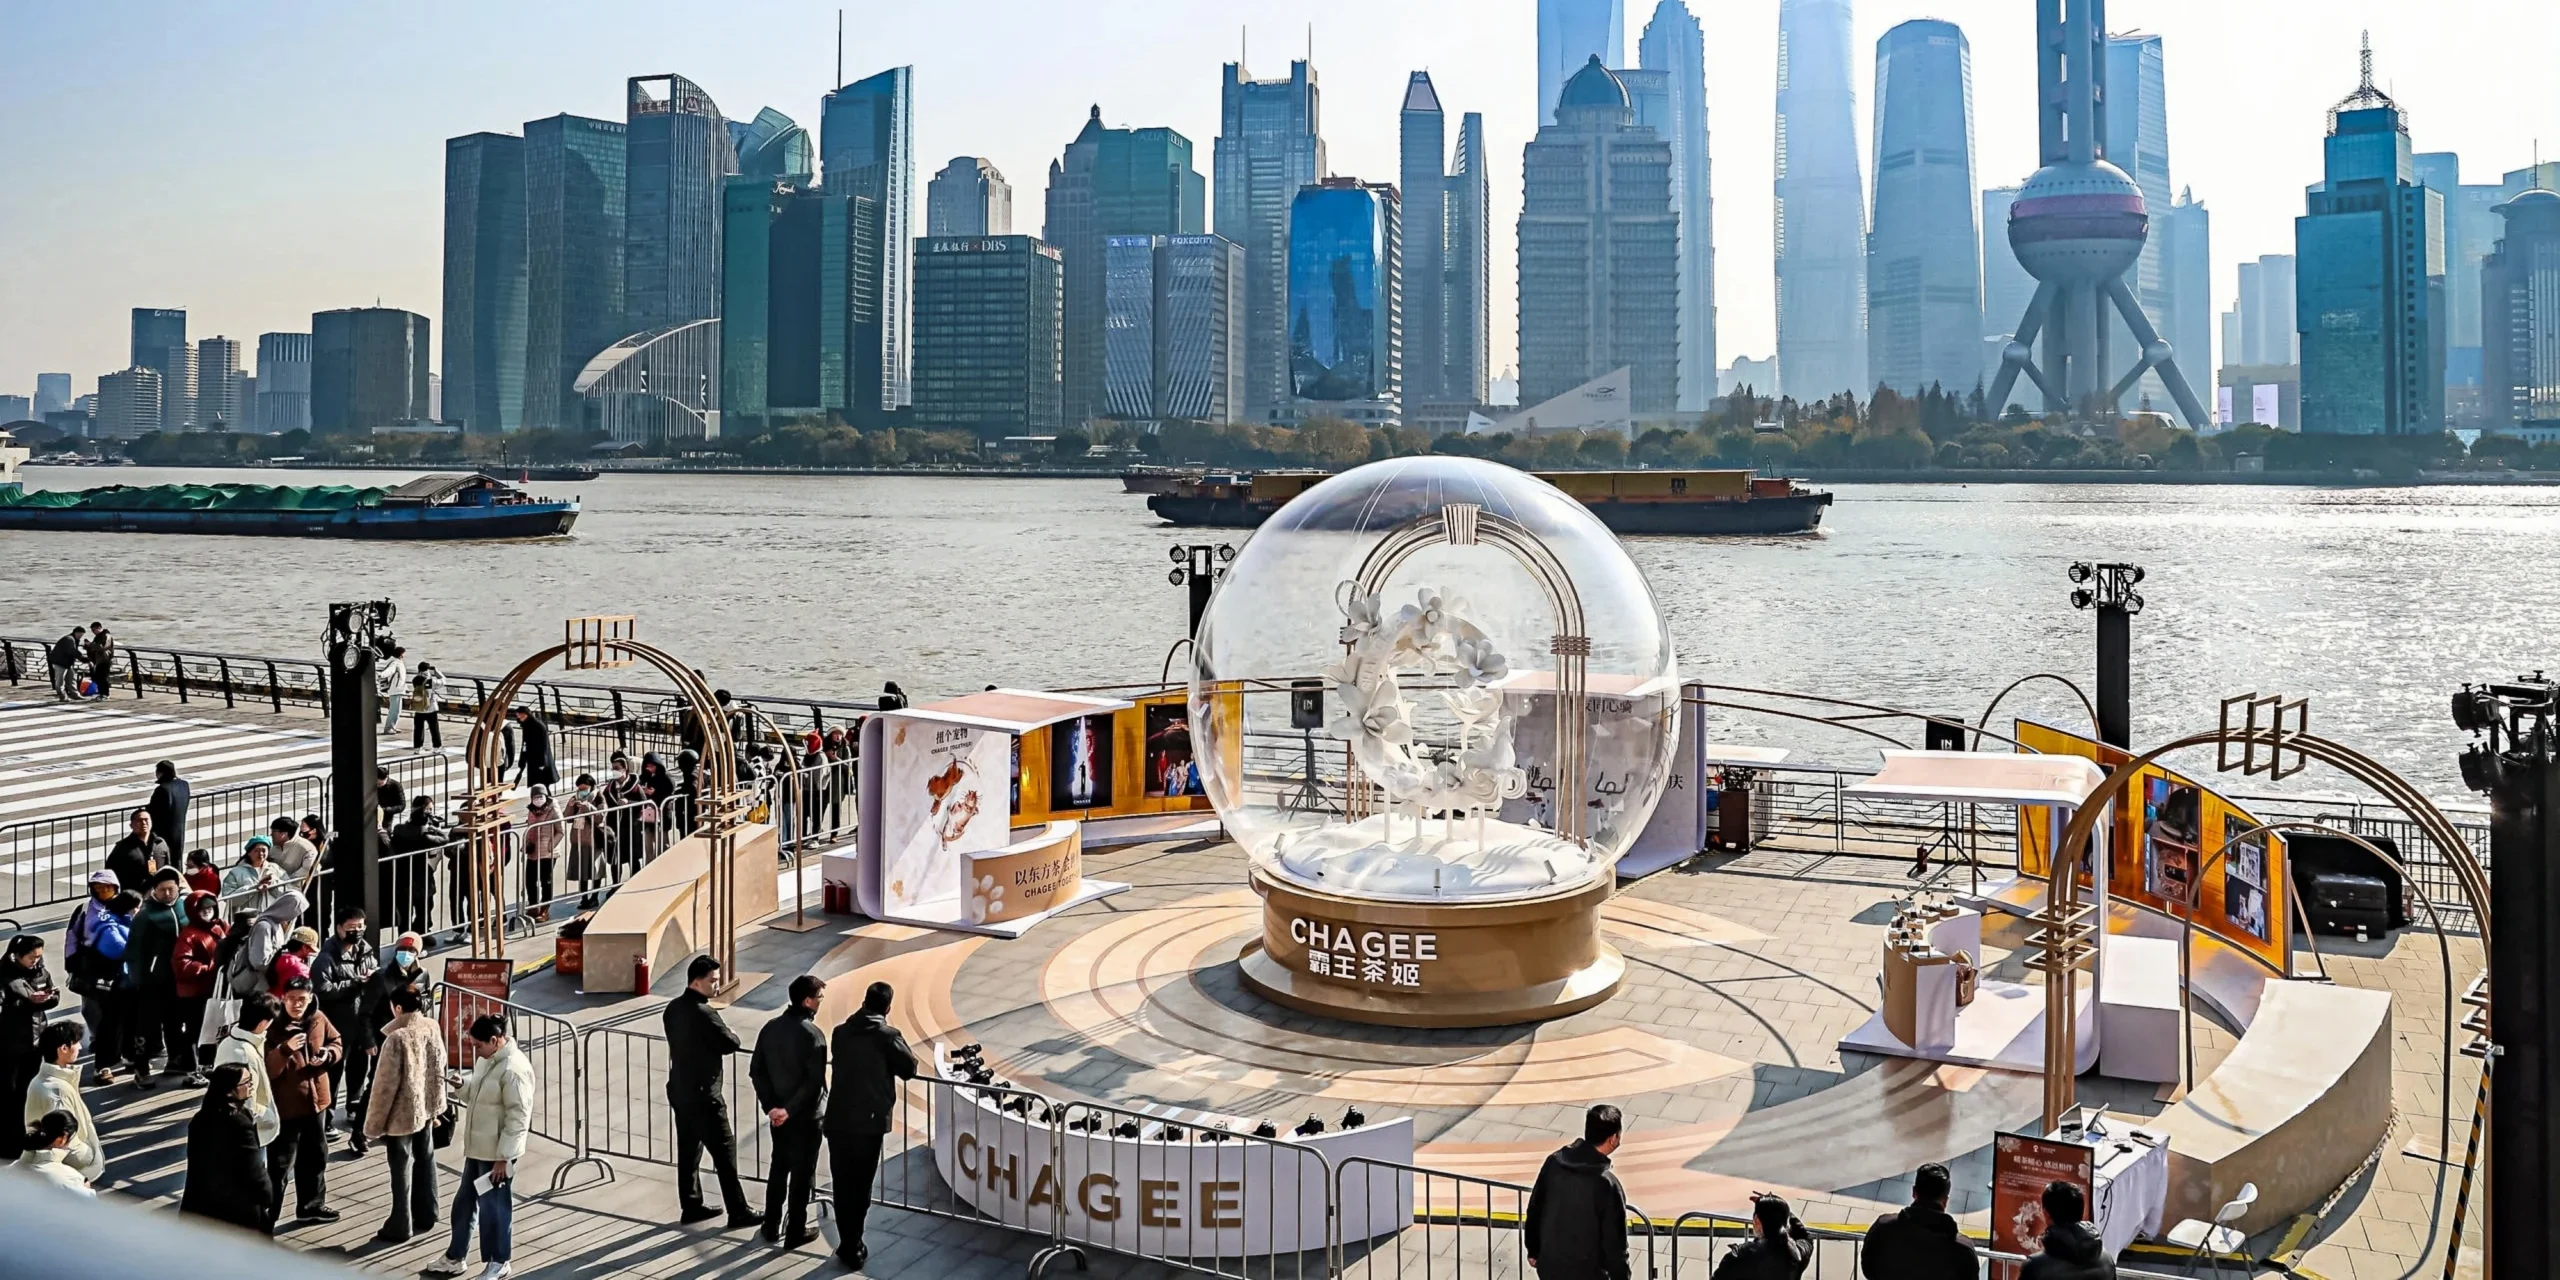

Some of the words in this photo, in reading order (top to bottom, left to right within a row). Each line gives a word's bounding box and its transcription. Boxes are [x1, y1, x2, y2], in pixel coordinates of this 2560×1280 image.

[981, 240, 1007, 252] DBS
[1024, 881, 1056, 899] CHAGEE
[1290, 917, 1438, 961] CHAGEE
[1308, 949, 1421, 987] 霸王茶姬
[957, 1132, 1242, 1229] CHAGEE
